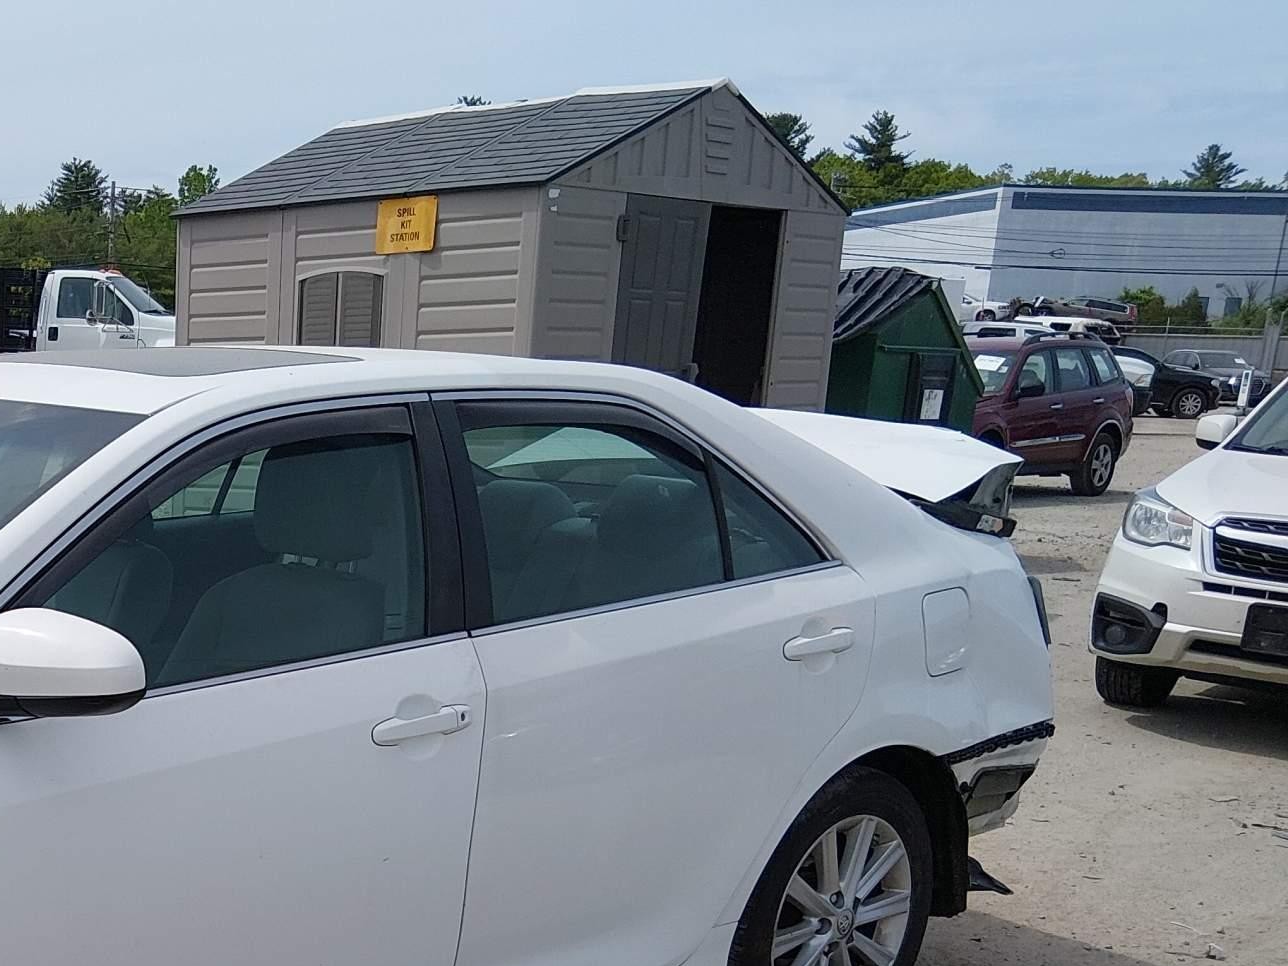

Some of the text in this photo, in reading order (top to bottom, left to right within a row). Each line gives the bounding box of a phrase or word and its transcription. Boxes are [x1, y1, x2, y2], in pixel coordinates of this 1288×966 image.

[397, 207, 416, 218] SPILL
[400, 219, 412, 230] KIT
[390, 231, 420, 242] STATION
